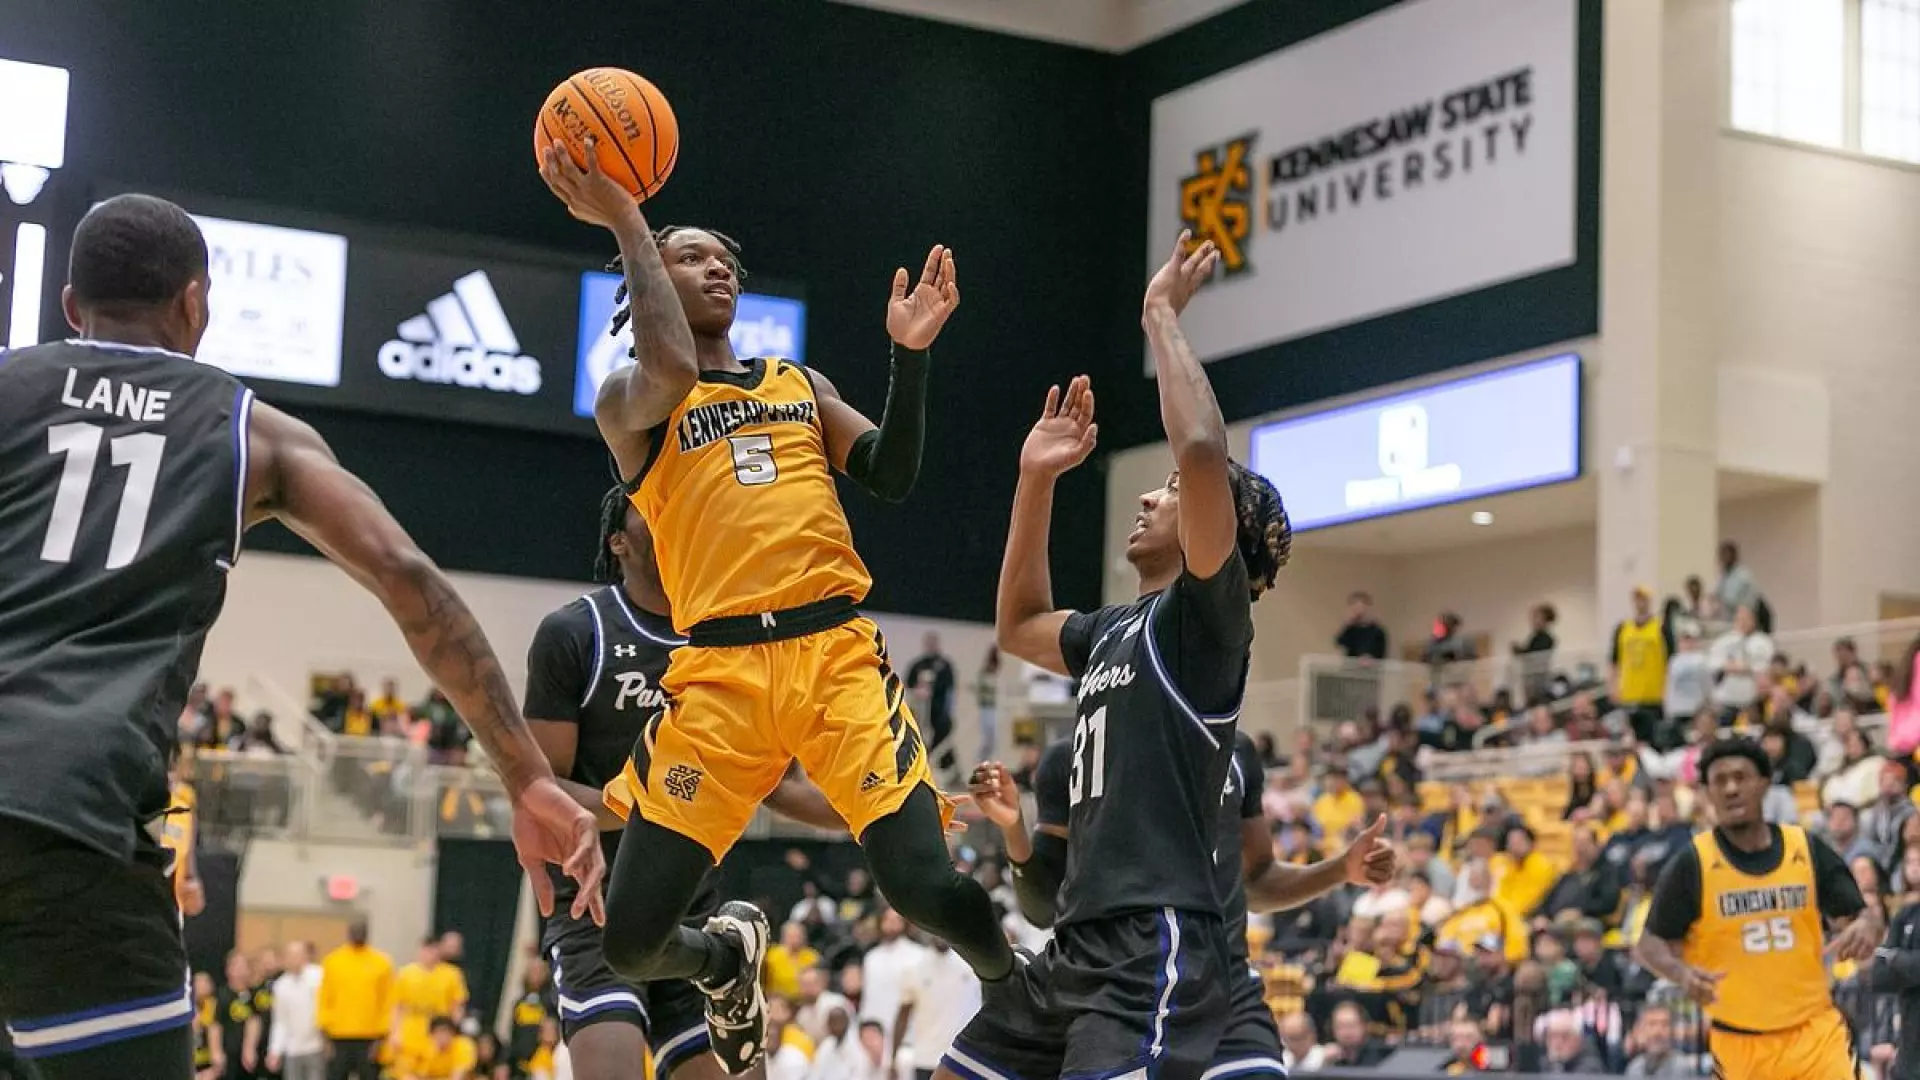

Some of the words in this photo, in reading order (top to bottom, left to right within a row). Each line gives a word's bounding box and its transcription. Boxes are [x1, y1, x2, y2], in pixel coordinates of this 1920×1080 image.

[584, 70, 641, 141] Wilson
[1270, 101, 1433, 186] KENNESAW
[1440, 66, 1533, 132] STATE
[1268, 113, 1532, 233] UNIVERSITY
[61, 367, 171, 421] LANE
[378, 338, 541, 394] adidas
[40, 421, 166, 569] 11
[728, 433, 778, 486] 5
[1069, 705, 1107, 807] 31
[1741, 916, 1795, 952] 25
